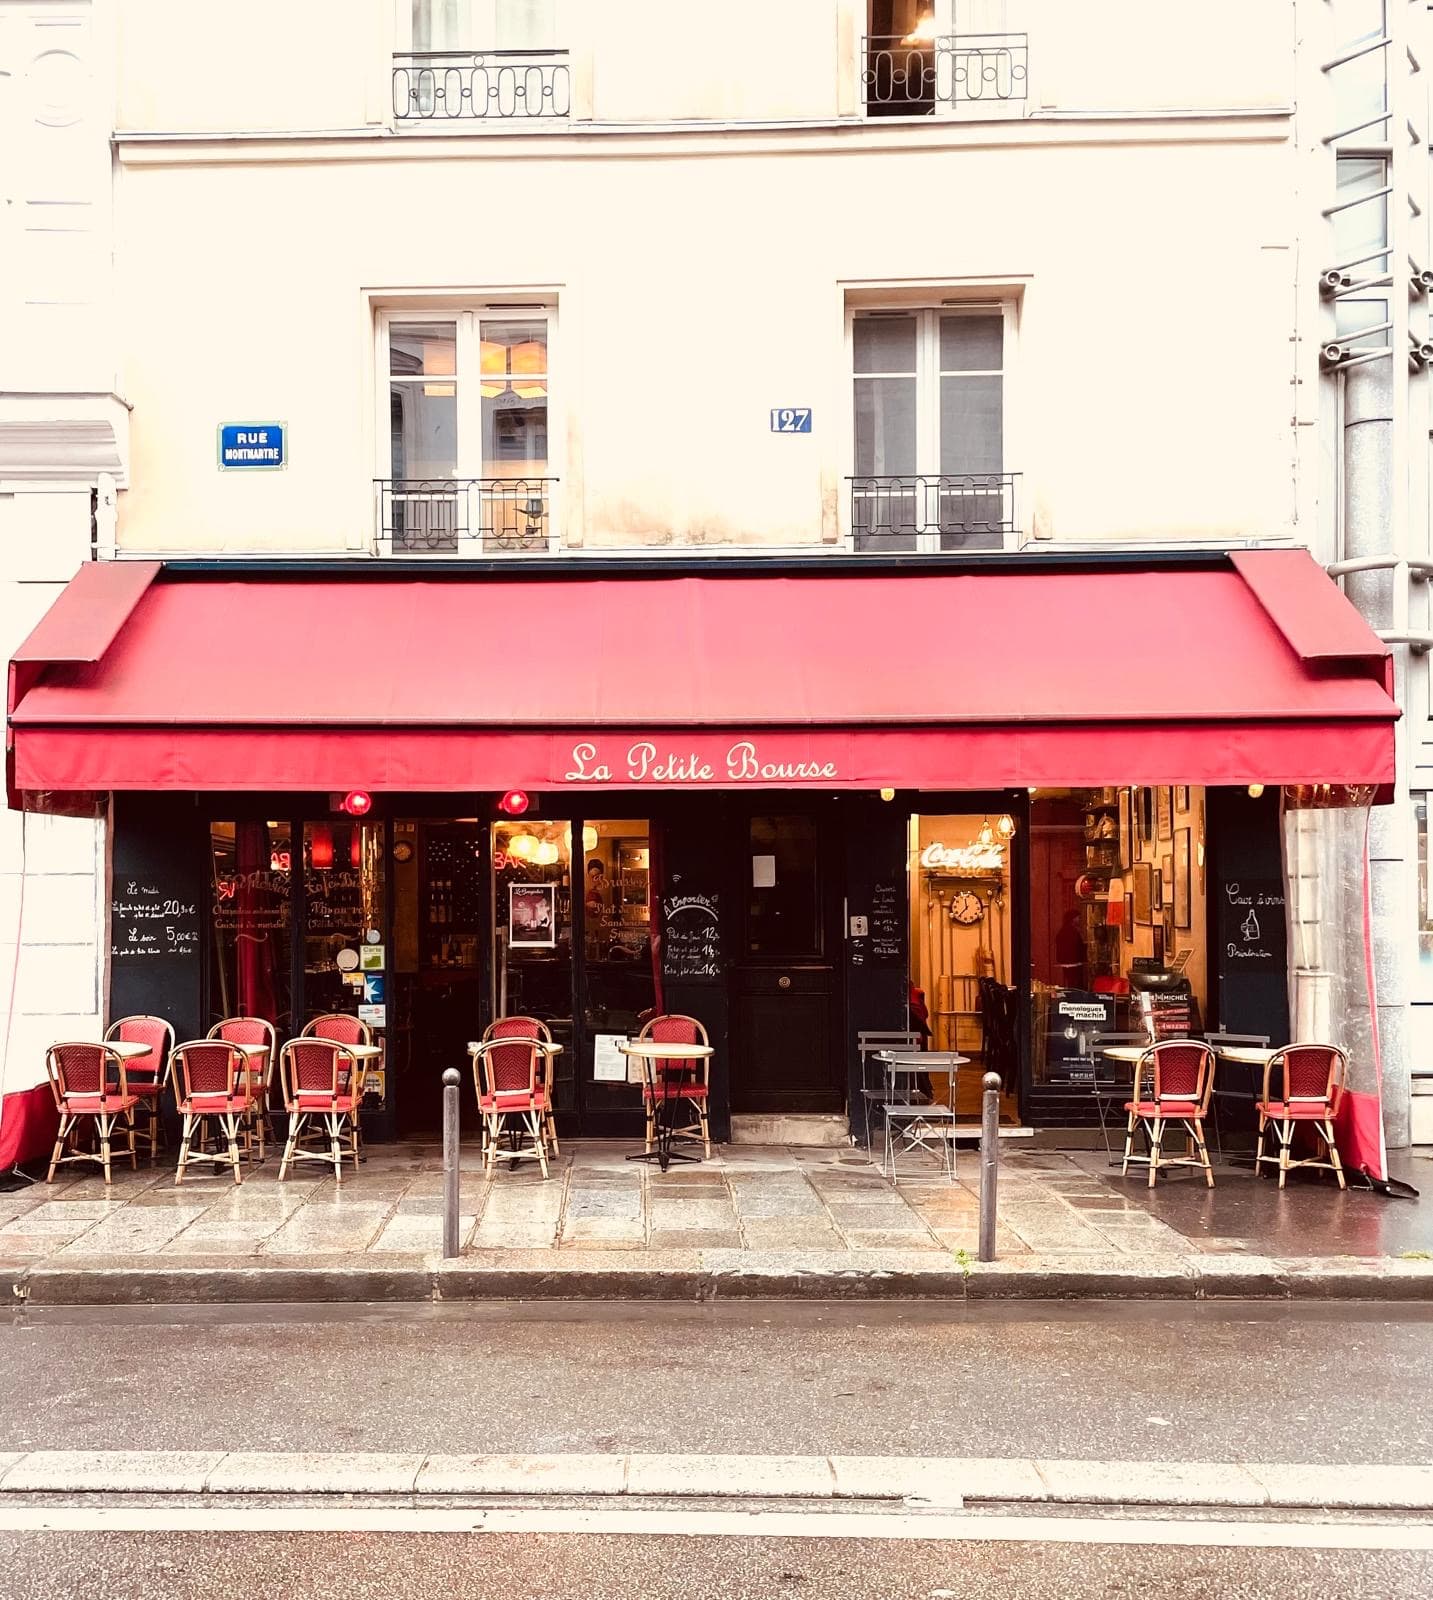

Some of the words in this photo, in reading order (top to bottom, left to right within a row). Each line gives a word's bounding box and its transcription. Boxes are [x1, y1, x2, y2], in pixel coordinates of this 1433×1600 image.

[772, 410, 809, 431] 127
[237, 432, 268, 444] RUE
[225, 448, 279, 460] MONTMARTRE
[565, 743, 613, 781] La
[627, 742, 714, 781] Petite
[726, 741, 838, 780] Bourse
[1226, 883, 1252, 904] Cave
